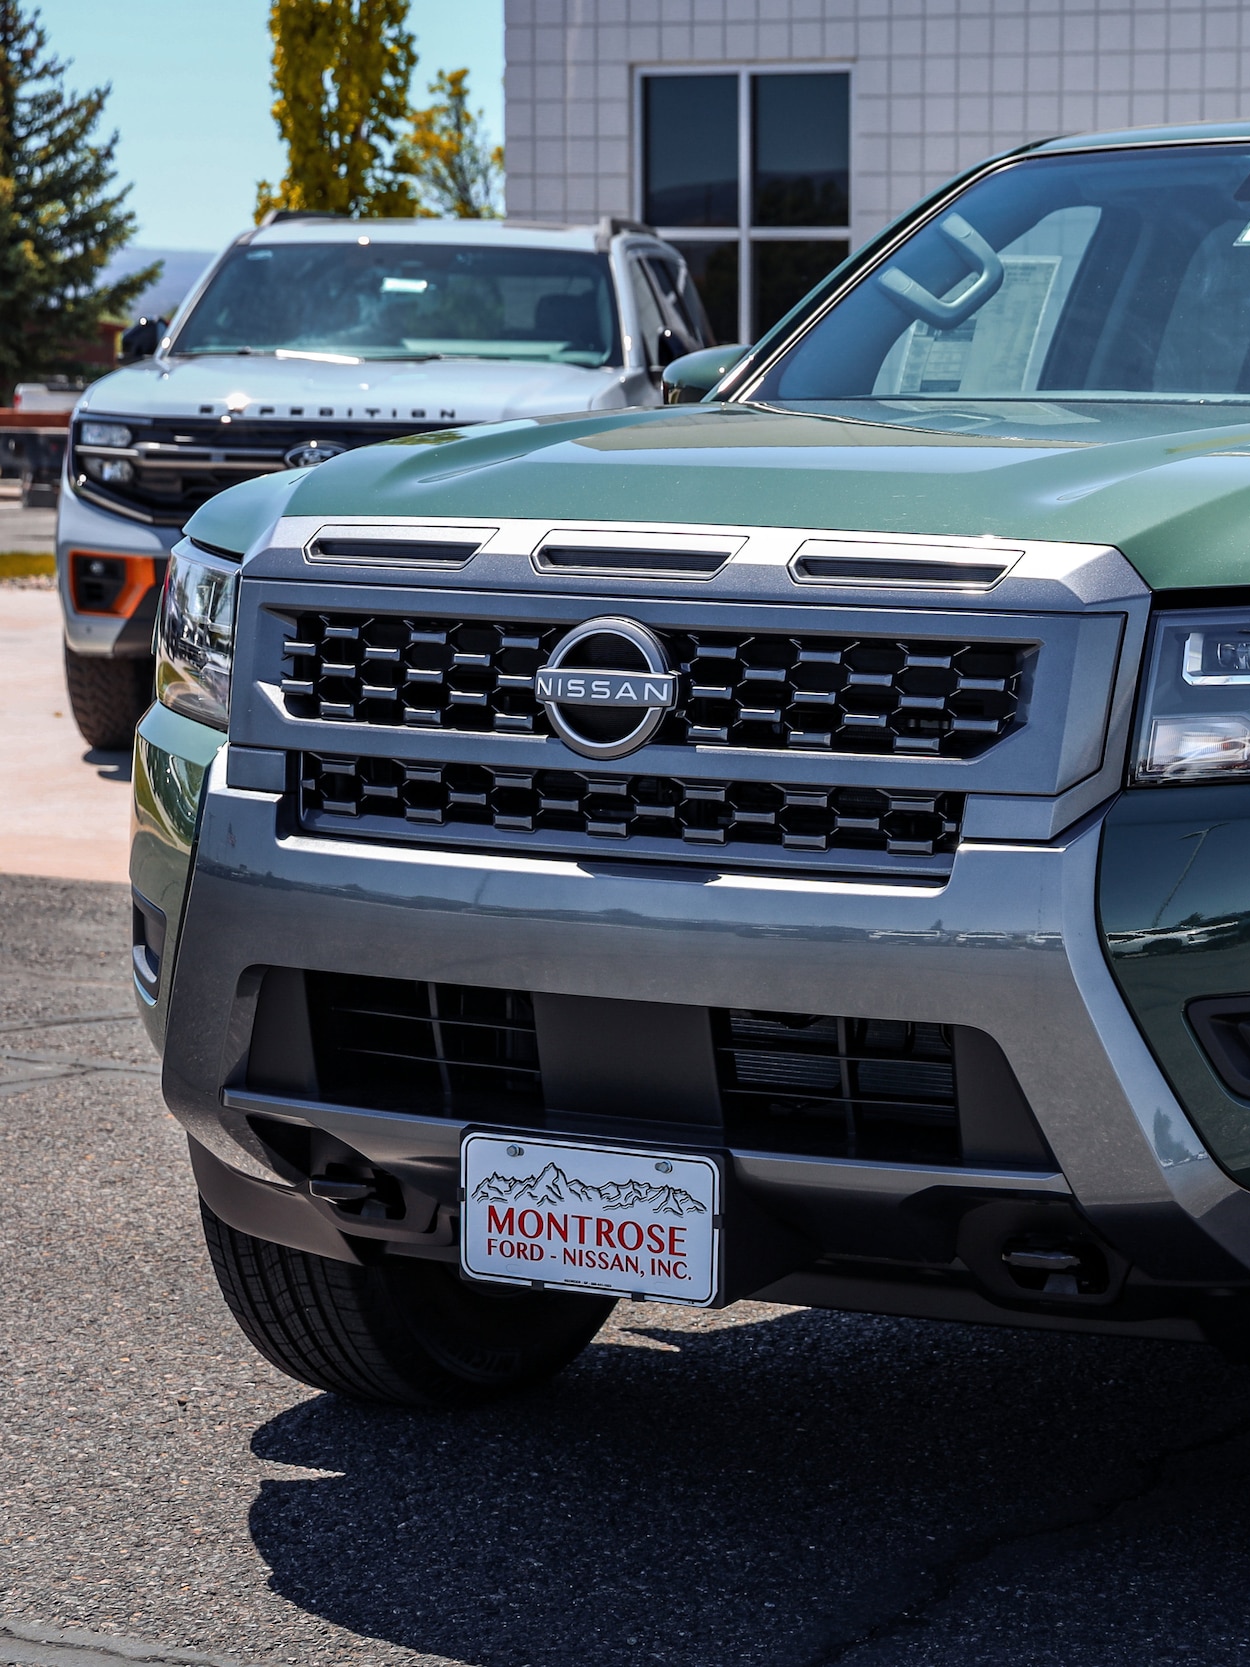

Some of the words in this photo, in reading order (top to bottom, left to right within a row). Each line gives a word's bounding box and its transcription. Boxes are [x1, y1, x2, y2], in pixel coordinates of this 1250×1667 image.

[537, 677, 669, 702] NISSAN
[487, 1205, 687, 1257] MONTROSE
[487, 1238, 545, 1262] FORD
[563, 1249, 645, 1278] NISSAN,
[650, 1258, 692, 1281] INC.
